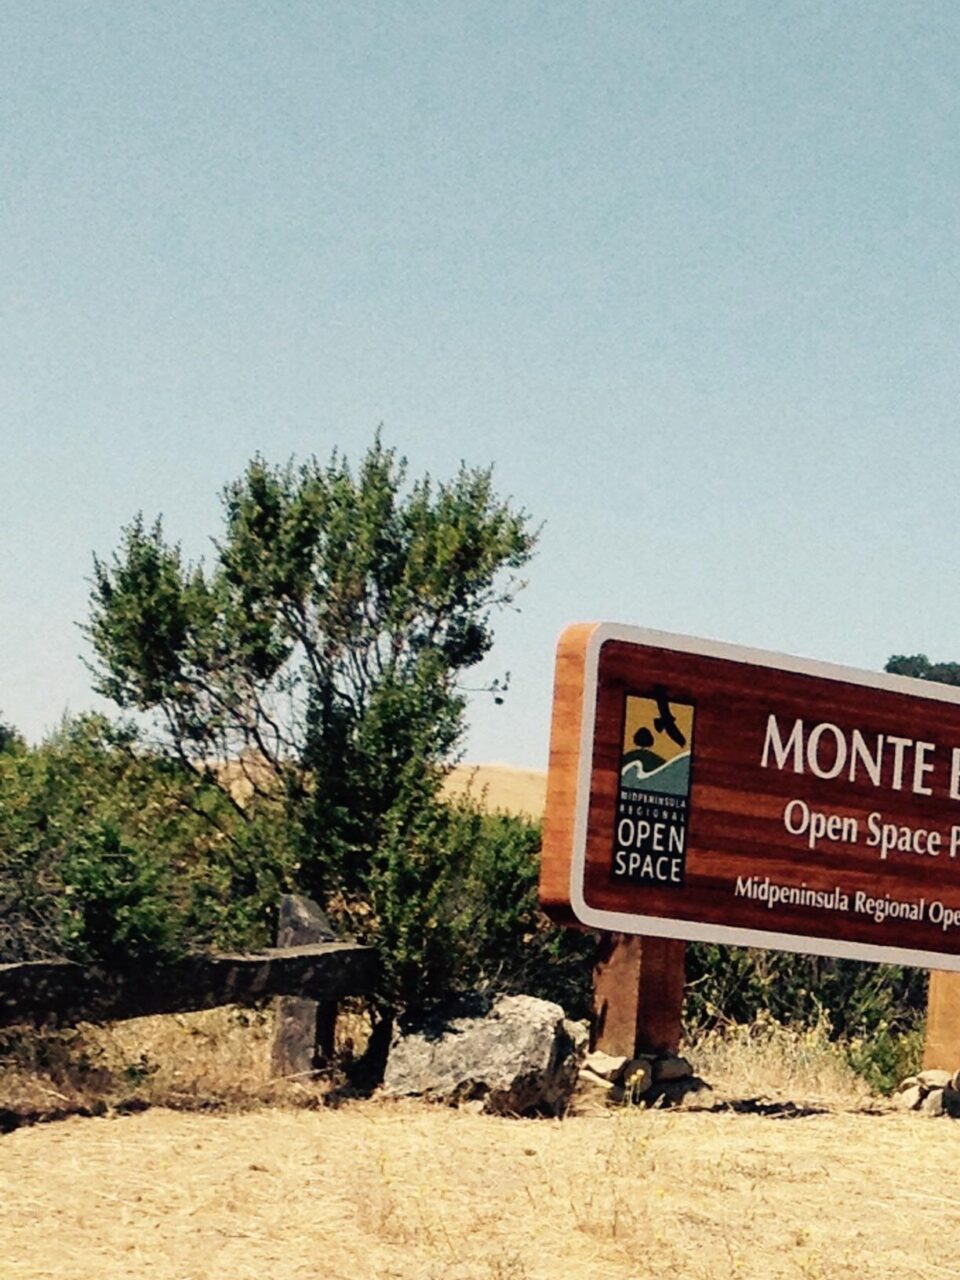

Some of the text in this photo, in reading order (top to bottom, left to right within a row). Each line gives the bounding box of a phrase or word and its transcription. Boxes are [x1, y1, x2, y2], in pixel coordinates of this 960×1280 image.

[760, 714, 935, 797] MONTE
[619, 804, 685, 822] REGIONAL
[620, 790, 686, 809] MIDPENINSULA
[617, 818, 685, 854] OPEN
[783, 799, 858, 849] Open
[866, 812, 941, 860] Space
[614, 851, 682, 883] SPACE
[734, 876, 849, 912] Midpeninsula
[855, 891, 924, 923] Regional
